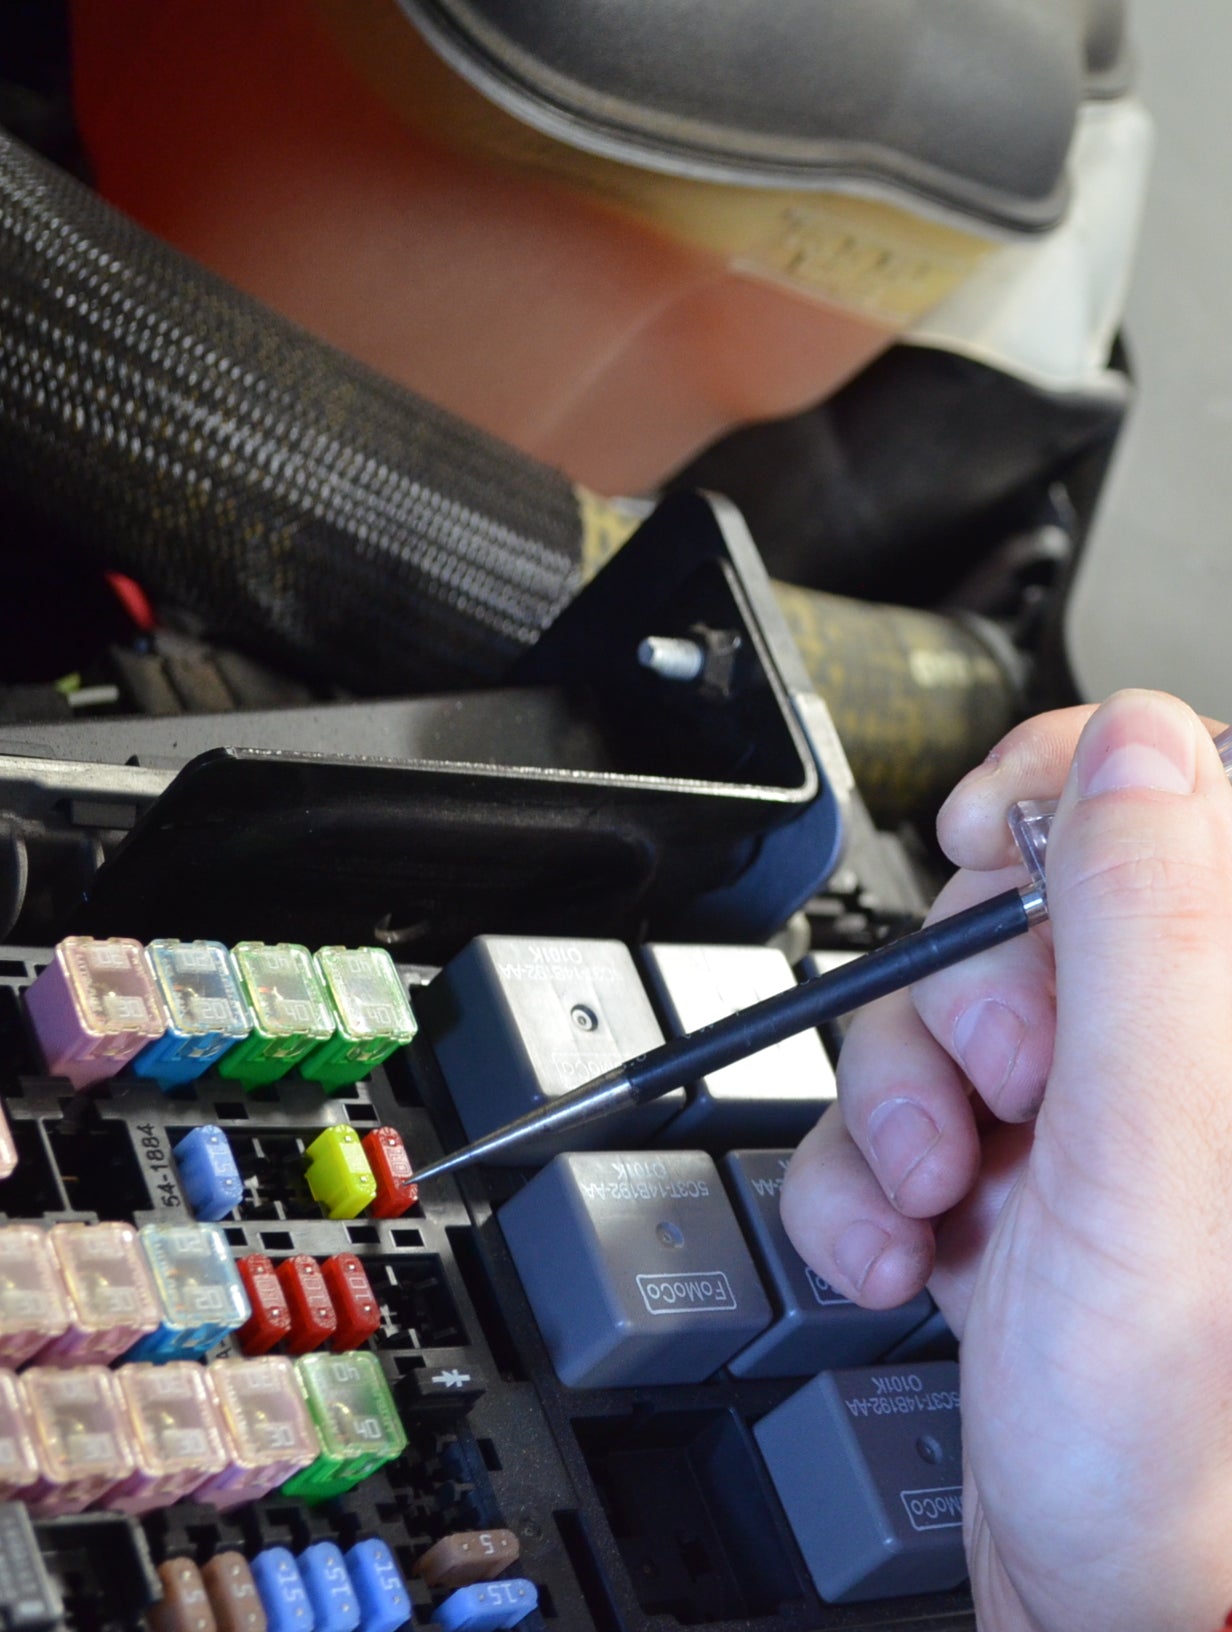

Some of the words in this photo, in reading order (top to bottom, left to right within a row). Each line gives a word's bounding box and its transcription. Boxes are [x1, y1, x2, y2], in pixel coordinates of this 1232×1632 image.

[199, 1002, 228, 1020] 20
[283, 1004, 311, 1023] 40
[367, 1006, 393, 1025] 40
[136, 1122, 181, 1207] 54-1884
[582, 1179, 710, 1200] 5C3T-14B192-AA
[349, 1276, 373, 1301] 10
[646, 1279, 728, 1303] FoMoCo
[194, 1292, 223, 1310] 20
[270, 1425, 296, 1447] 30
[353, 1418, 383, 1440] 40
[910, 1494, 962, 1519] MoCo
[479, 1533, 496, 1555] 5
[278, 1572, 304, 1602] 15
[325, 1566, 350, 1598] 15
[374, 1560, 401, 1591] 15
[486, 1582, 519, 1606] 15
